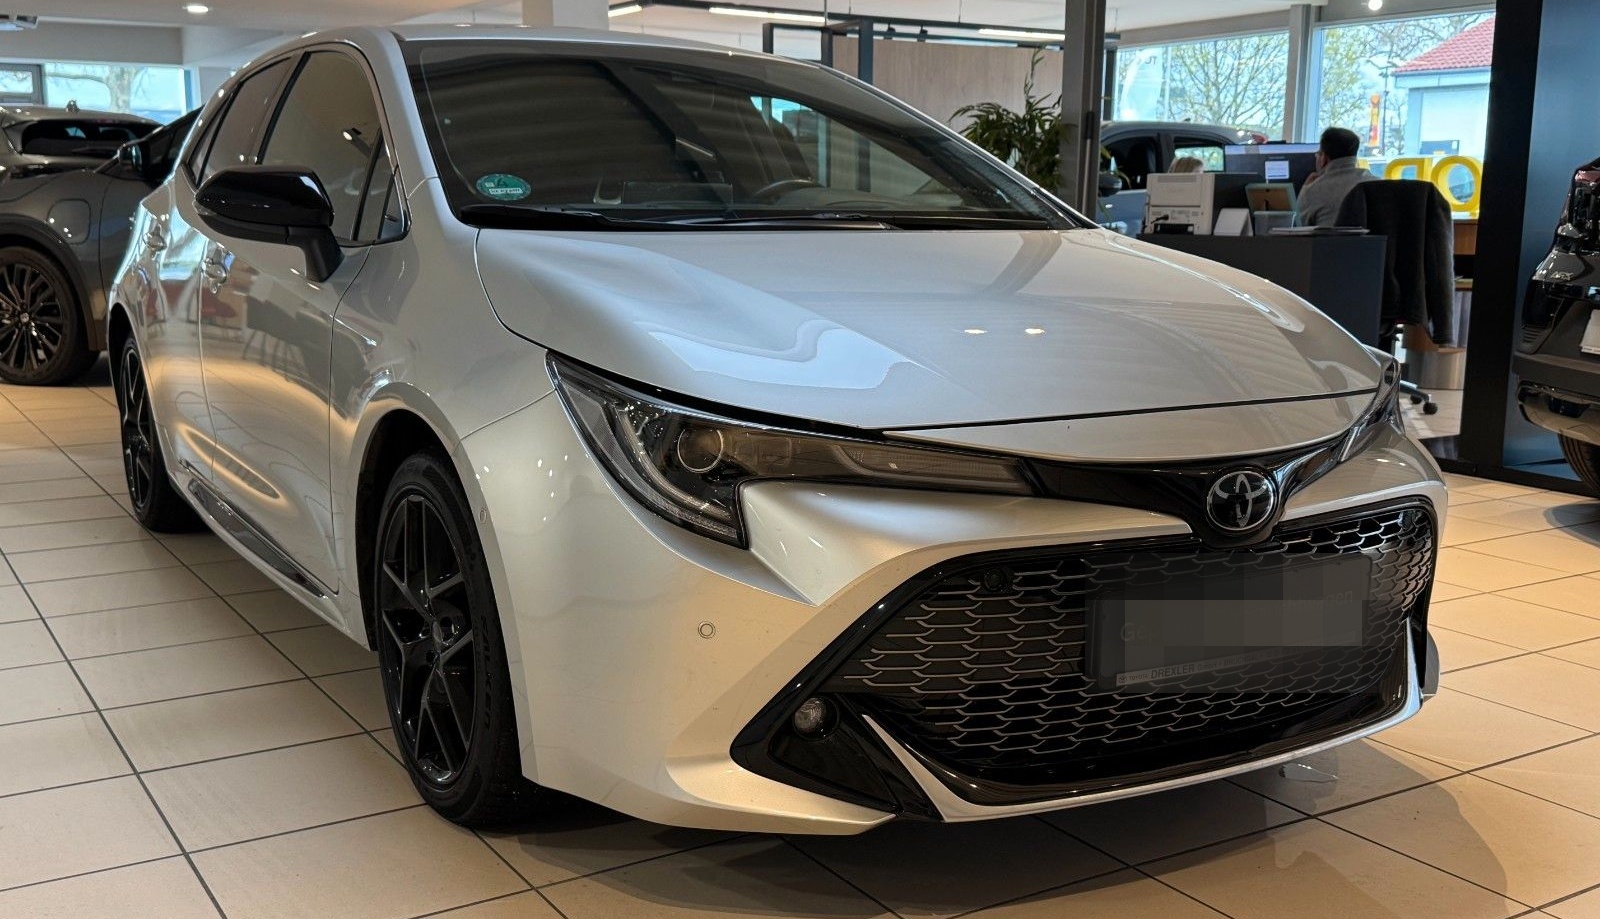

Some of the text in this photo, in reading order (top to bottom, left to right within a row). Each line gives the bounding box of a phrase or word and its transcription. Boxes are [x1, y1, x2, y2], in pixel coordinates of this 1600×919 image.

[1128, 674, 1149, 682] TOYOTA
[1151, 663, 1195, 680] DREXLER
[1197, 662, 1217, 672] GmbH
